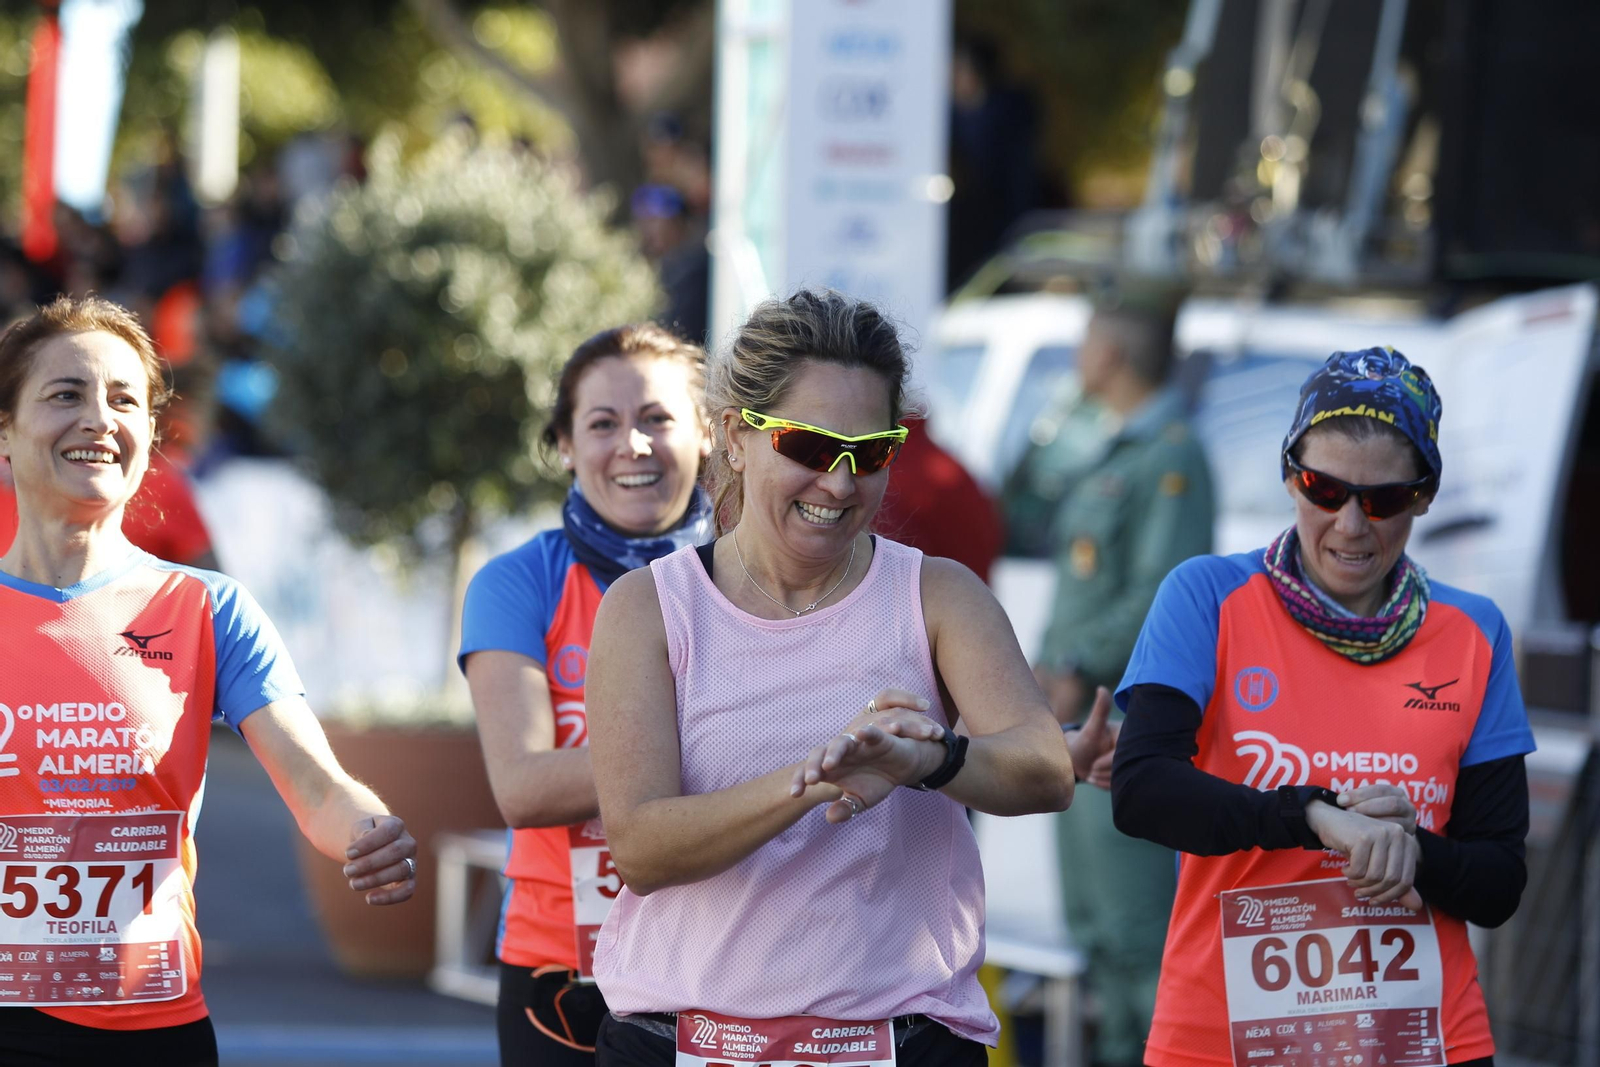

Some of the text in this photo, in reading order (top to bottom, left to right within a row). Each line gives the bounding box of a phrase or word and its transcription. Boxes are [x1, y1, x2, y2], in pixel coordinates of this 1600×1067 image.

[35, 702, 127, 723] MEDIO
[1331, 751, 1418, 775] MEDIO
[39, 778, 137, 793] 03/02/2019
[24, 827, 54, 835] MEDIO
[111, 825, 168, 838] CARRERA
[24, 835, 71, 844] MARATÓN
[24, 843, 65, 853] ALMERÍA
[94, 840, 168, 853] SALUDABLE
[0, 863, 154, 918] 5371
[1269, 896, 1300, 906] MEDIO
[1270, 902, 1317, 916] MARATÓN
[1341, 906, 1417, 918] SALUDABLE
[1271, 912, 1312, 925] ALMERÍA
[47, 921, 117, 934] TEOFILA
[1251, 928, 1419, 992] 6042
[1297, 985, 1379, 1005] MARIMAR
[724, 1024, 752, 1033] MEDIO
[811, 1025, 875, 1039] CARRERA
[722, 1033, 768, 1044] MARATÓN
[722, 1042, 762, 1053] ALMERÍA
[793, 1040, 876, 1054] SALUDABLE
[722, 1051, 755, 1059] 03/02/2019
